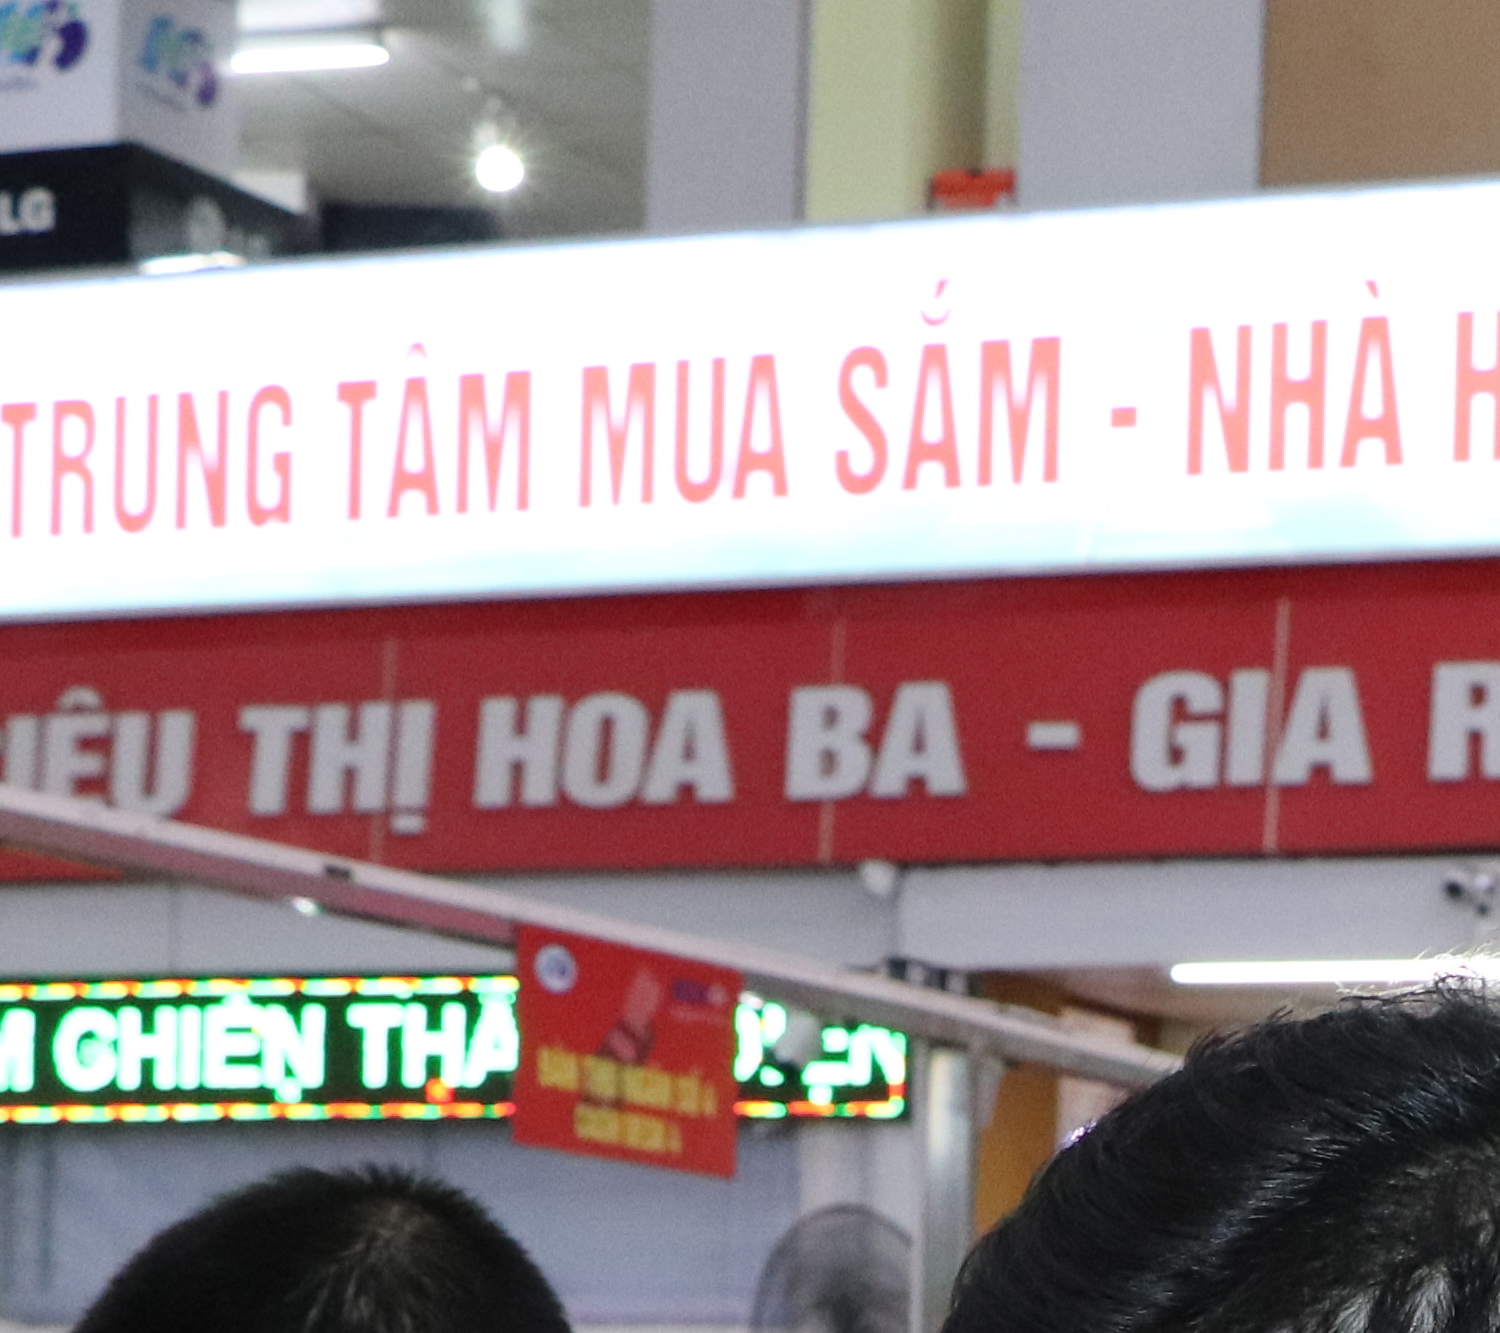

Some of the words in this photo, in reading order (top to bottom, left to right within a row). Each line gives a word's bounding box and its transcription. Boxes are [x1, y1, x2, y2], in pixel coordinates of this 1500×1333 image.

[0, 385, 295, 538] TRUNG
[337, 341, 533, 522] TÂM
[577, 352, 790, 513] MUA
[833, 278, 1061, 496] SẮM
[1187, 279, 1403, 475] NHÀ
[237, 696, 437, 836] THỊ
[472, 689, 735, 811] HOA
[781, 677, 967, 801] BA
